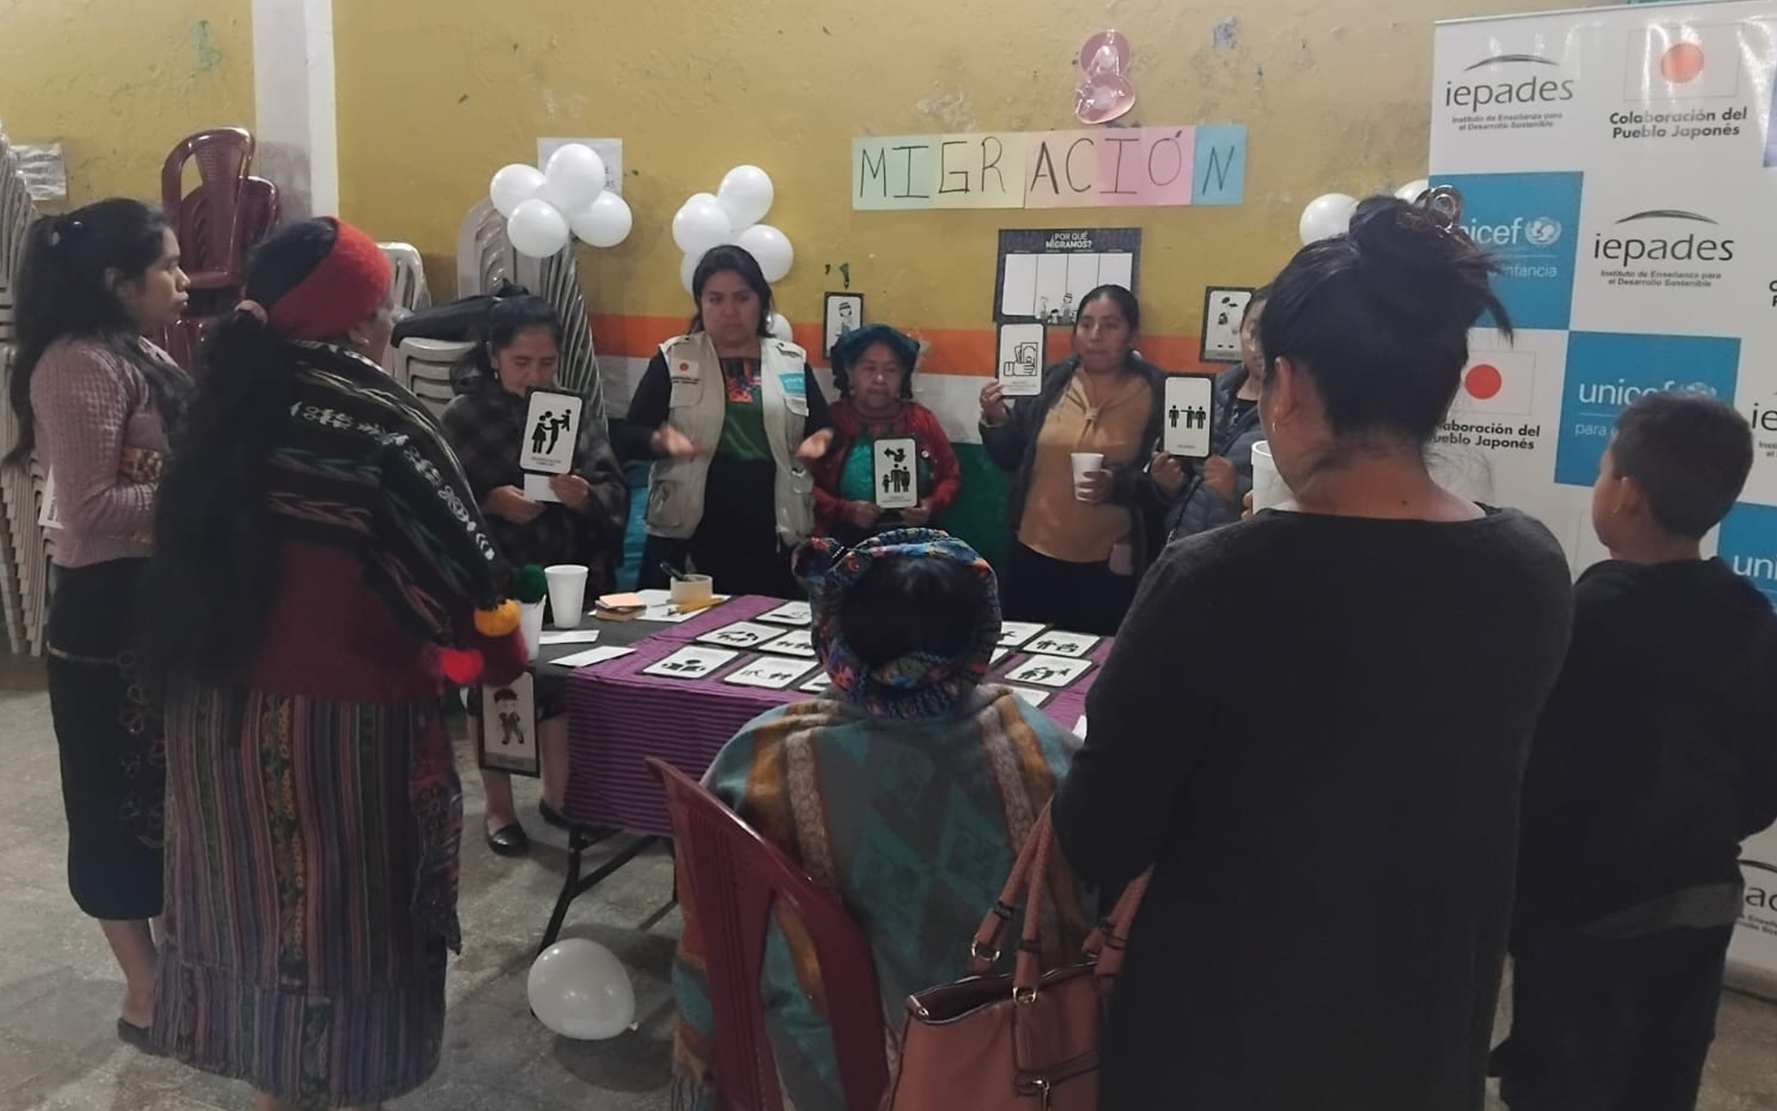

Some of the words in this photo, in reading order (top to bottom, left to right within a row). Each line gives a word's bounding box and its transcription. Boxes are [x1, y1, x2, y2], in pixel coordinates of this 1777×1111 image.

[1445, 75, 1574, 113] iepades
[1609, 110, 1716, 125] Colaboración
[1721, 106, 1747, 121] del
[1612, 125, 1667, 139] Pueblo
[1671, 122, 1741, 141] Japonés
[860, 130, 1234, 200] MIGRACIÓN
[1459, 217, 1523, 244] icef
[1594, 233, 1735, 267] iepades
[1579, 378, 1676, 406] unic
[1442, 419, 1513, 436] aboración
[1518, 424, 1540, 438] del
[1575, 423, 1607, 437] para
[1433, 432, 1471, 446] ueblo
[1475, 434, 1534, 450] Japonés
